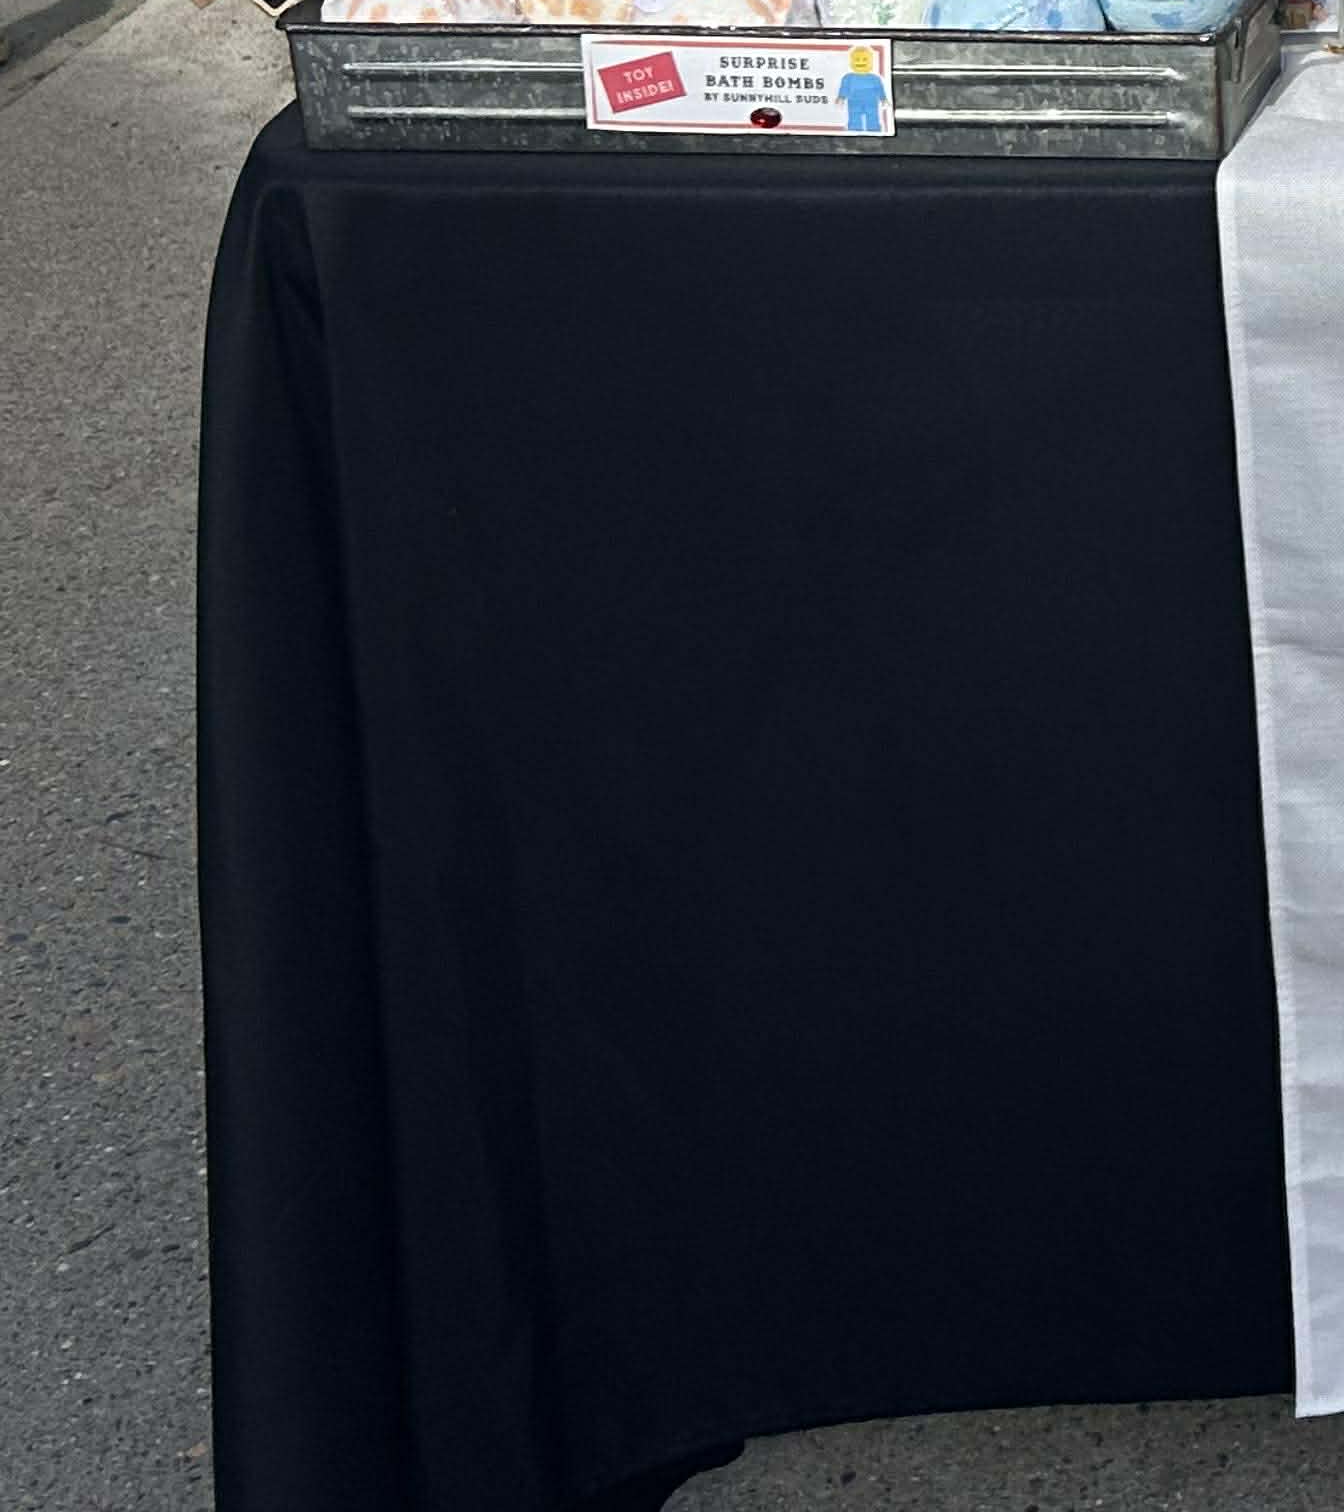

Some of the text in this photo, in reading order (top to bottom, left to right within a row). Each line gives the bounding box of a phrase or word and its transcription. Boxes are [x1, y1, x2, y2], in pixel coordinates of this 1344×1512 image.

[719, 55, 811, 71] SURPRISE
[623, 66, 656, 85] TOY
[705, 74, 826, 91] BATH BOMBS
[615, 79, 674, 105] INSIDE!
[703, 92, 829, 105] BY SUNNYHILL SUDS
